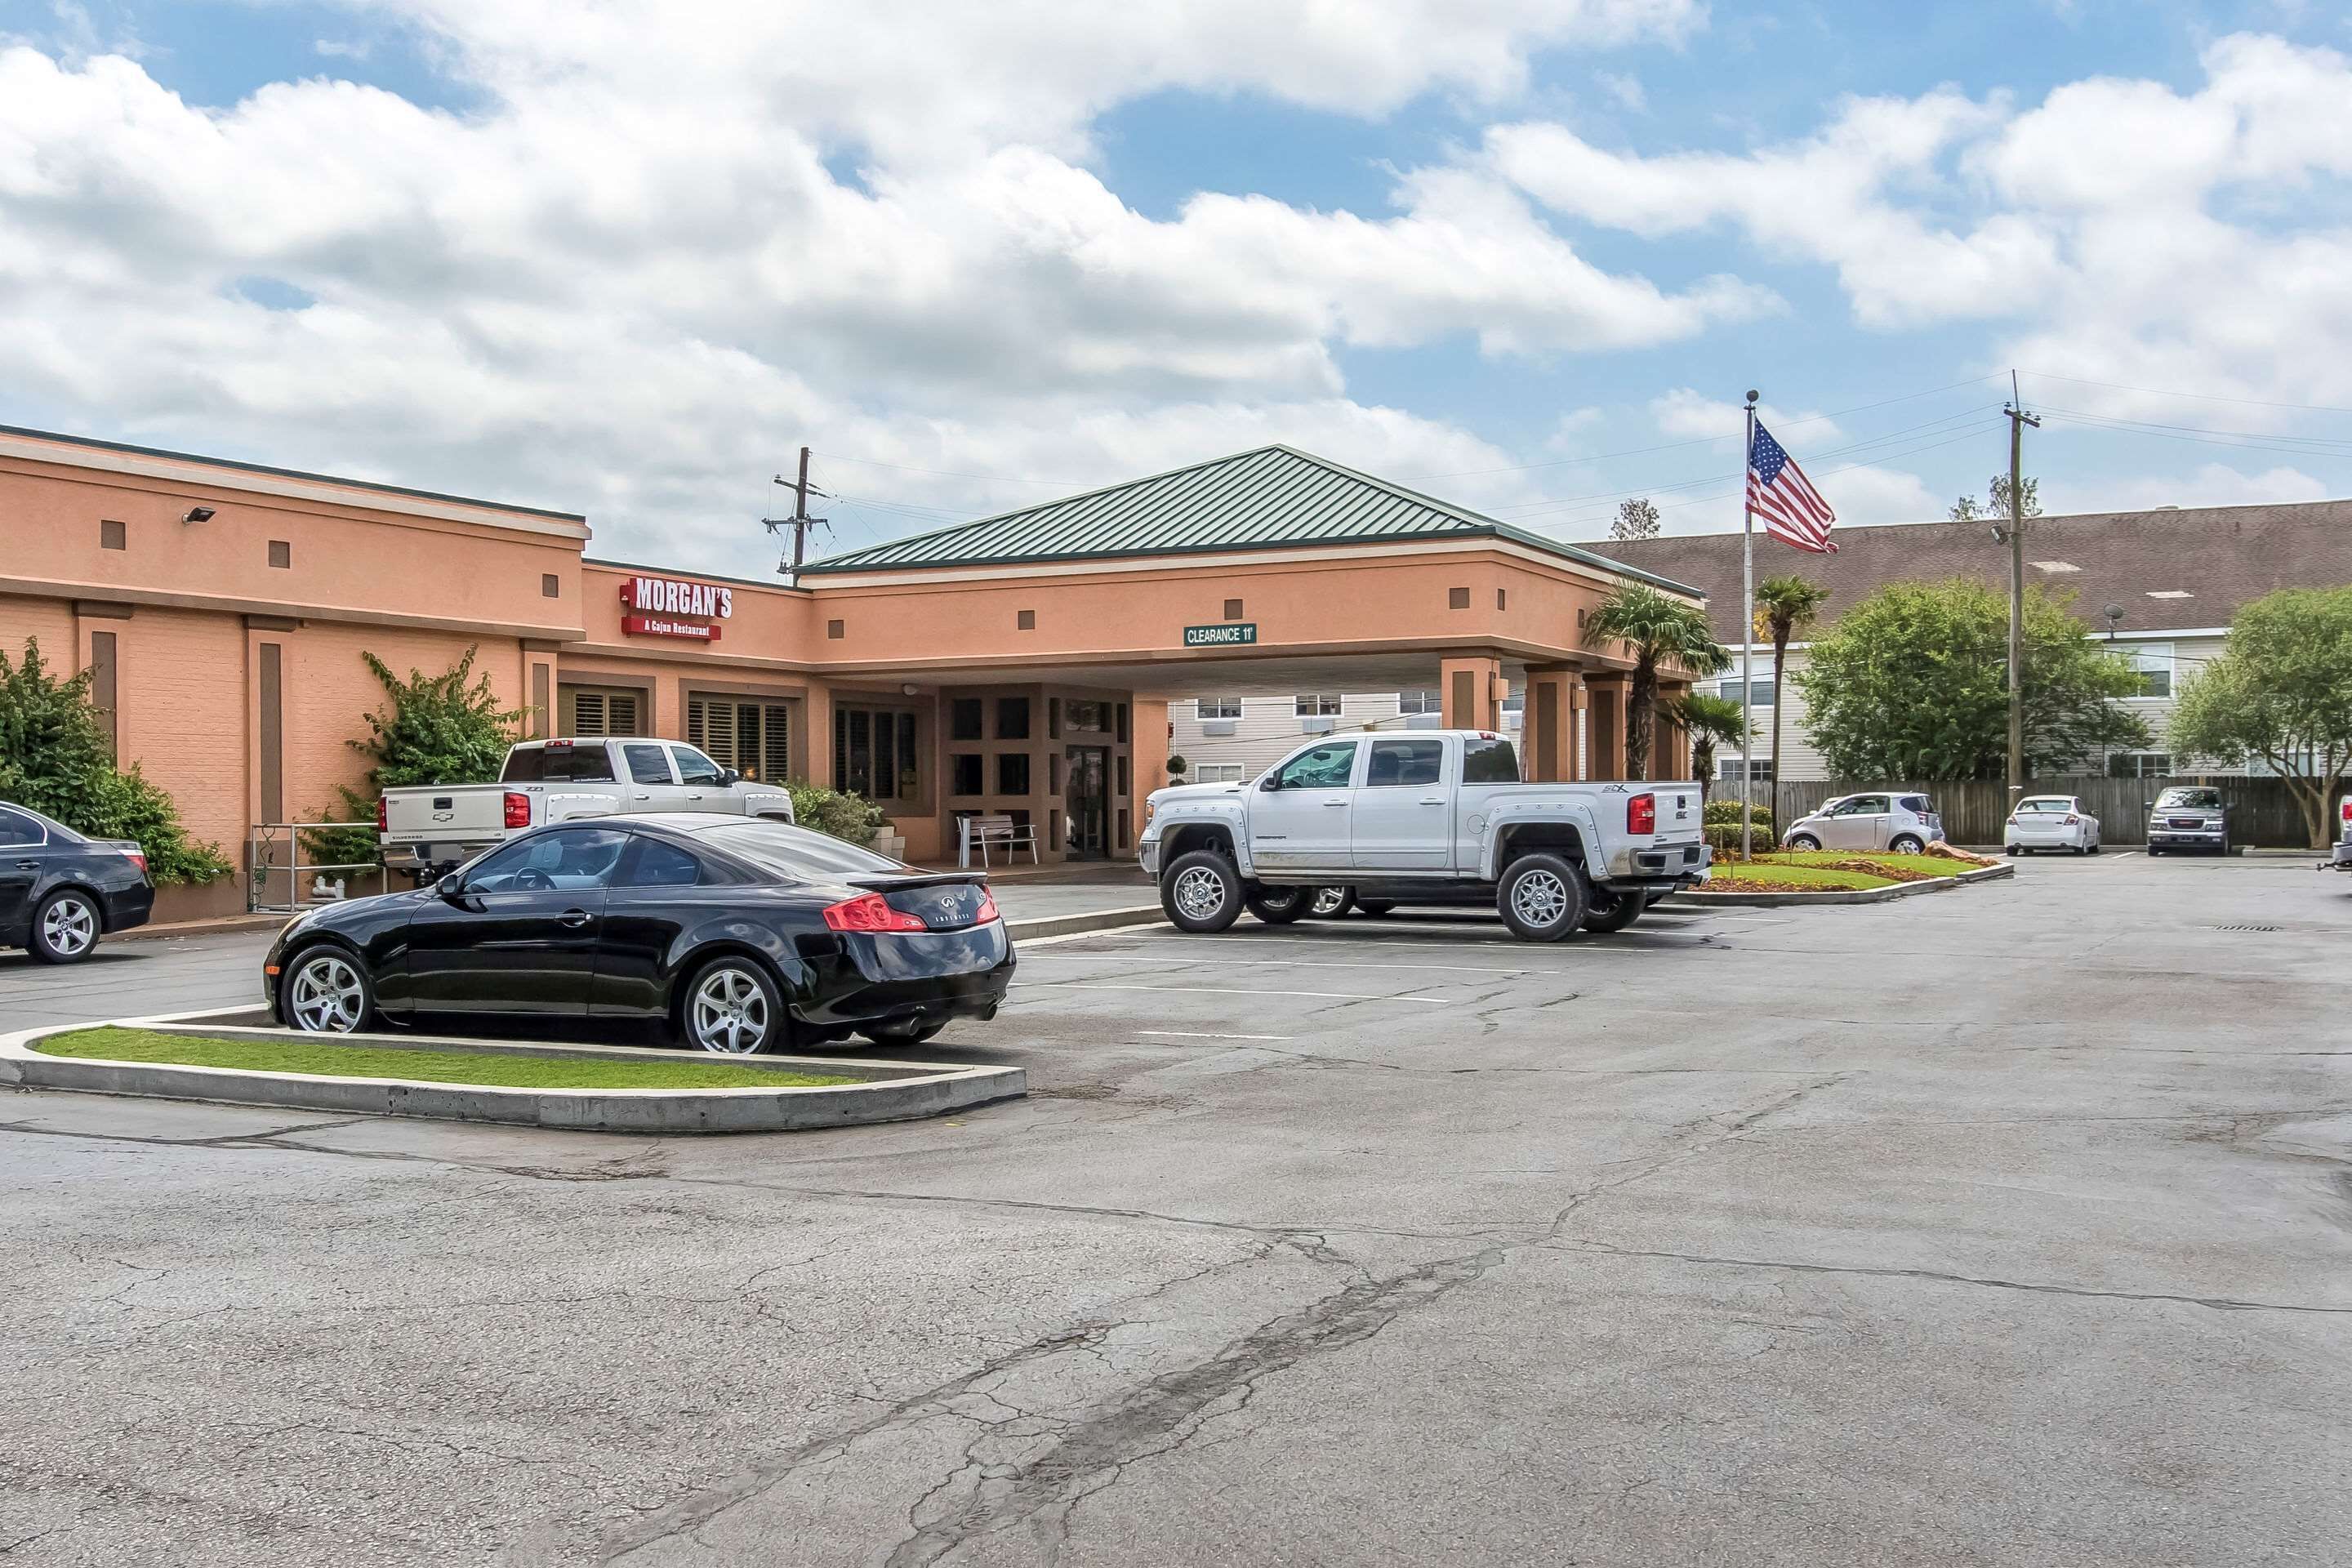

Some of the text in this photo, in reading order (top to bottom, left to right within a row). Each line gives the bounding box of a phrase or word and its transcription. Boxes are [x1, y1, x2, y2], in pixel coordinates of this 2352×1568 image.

[636, 577, 733, 619] MORGAN'S
[644, 620, 710, 636] A Cajun Restaurant
[1187, 627, 1240, 644] CLEARANCE
